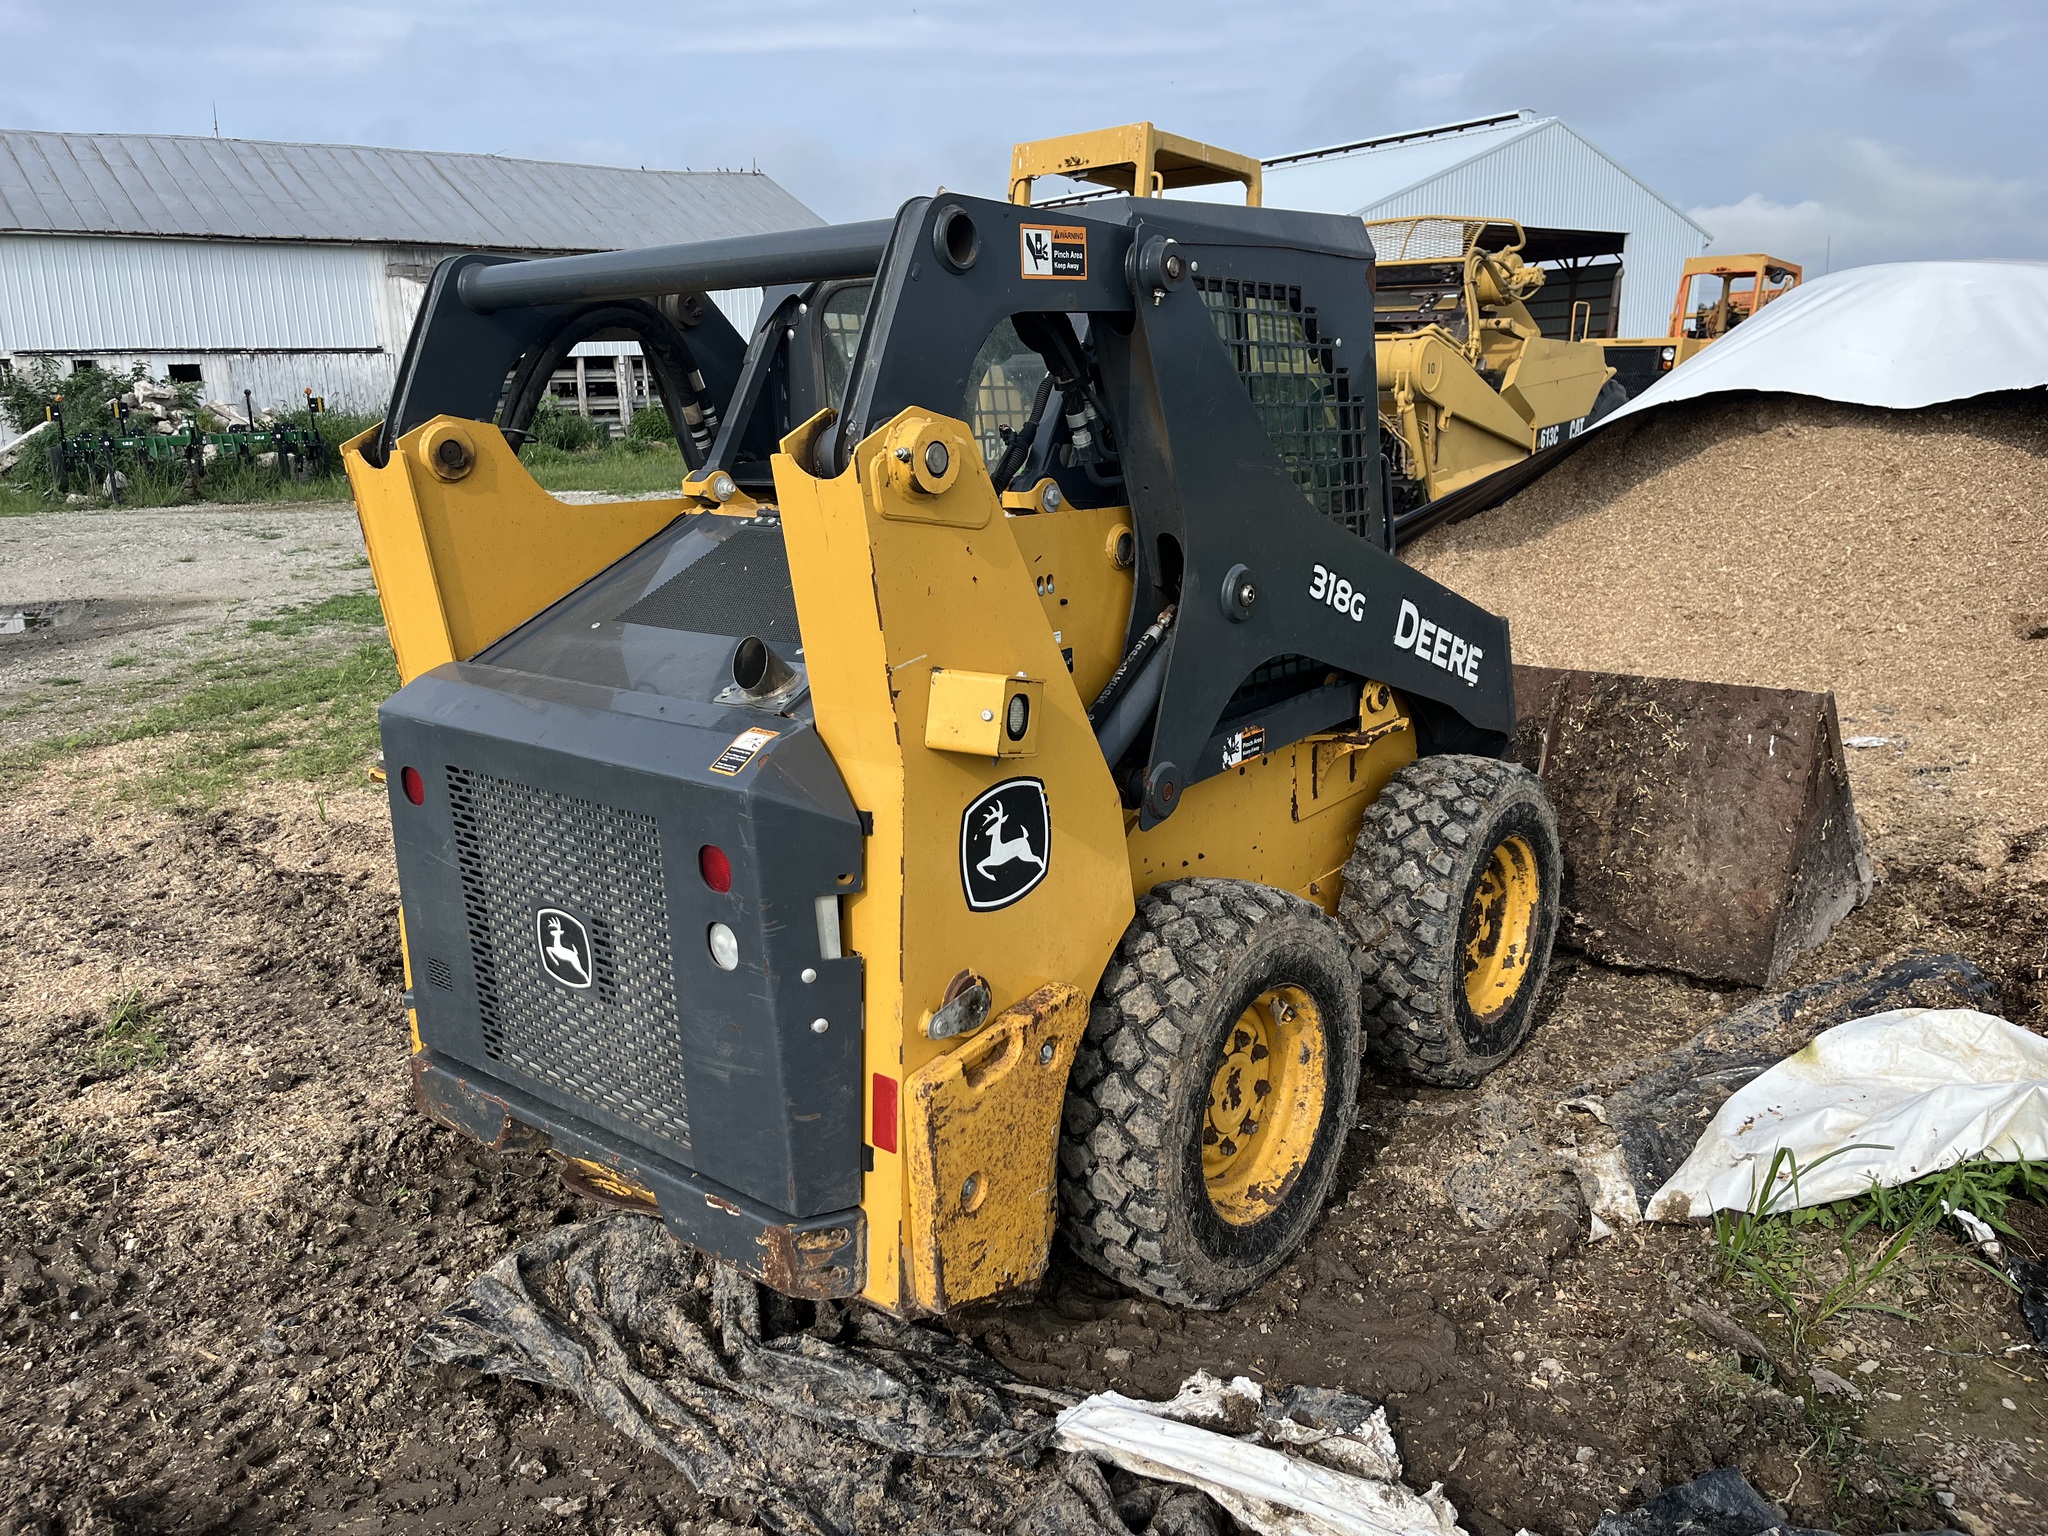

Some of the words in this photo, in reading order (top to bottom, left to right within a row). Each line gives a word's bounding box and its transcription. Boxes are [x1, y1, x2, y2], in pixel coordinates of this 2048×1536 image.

[1060, 231, 1083, 240] WARNING
[1053, 250, 1069, 259] Pinch
[1070, 250, 1083, 259] Area
[1053, 262, 1066, 270] Keep
[1067, 262, 1079, 271] Away
[1427, 362, 1435, 374] 10
[1540, 425, 1559, 449] 613C
[1569, 417, 1585, 439] CAT
[1309, 564, 1366, 622] 318G
[1393, 598, 1483, 686] DEERE
